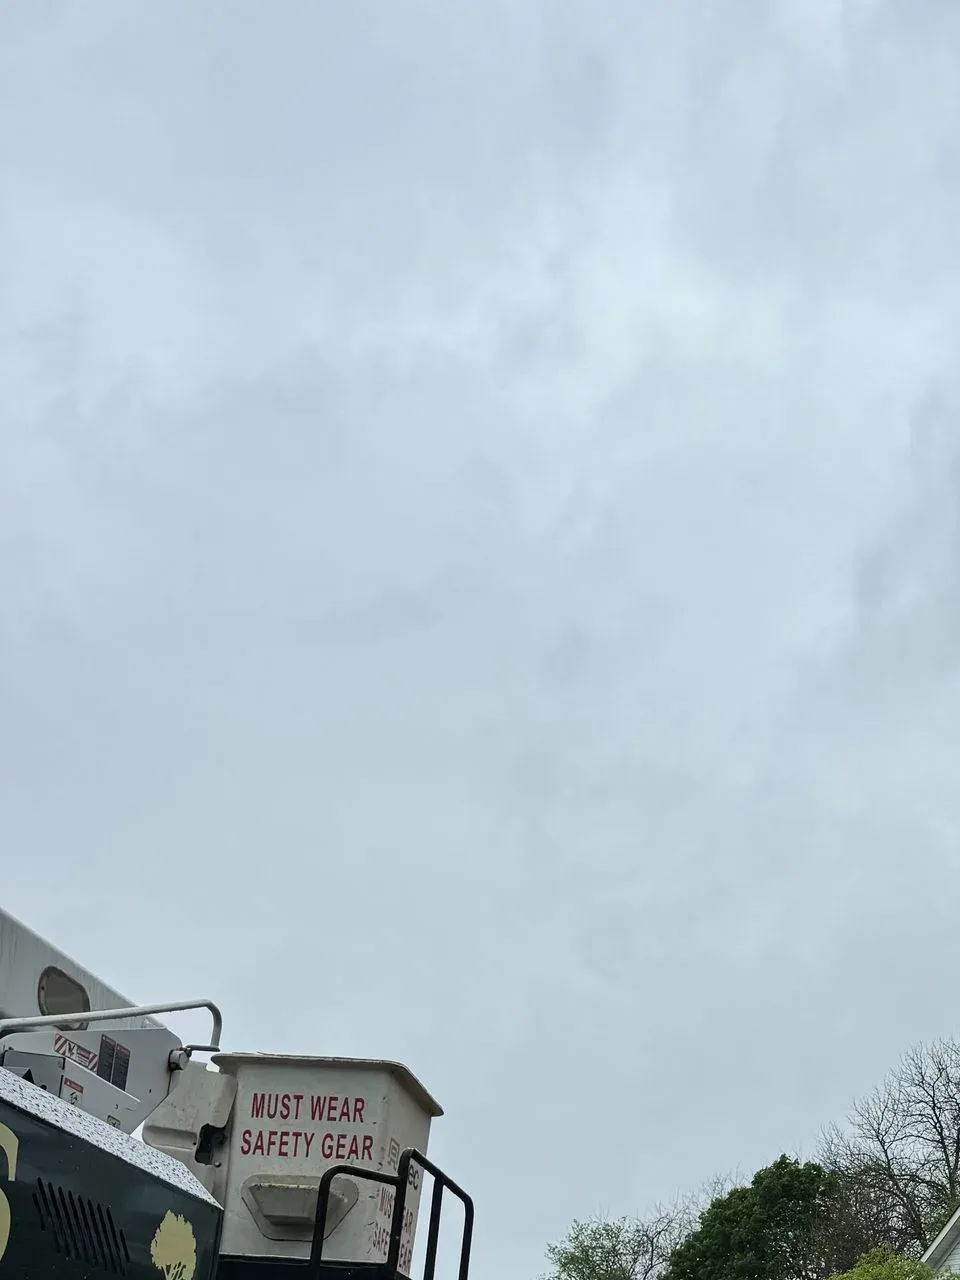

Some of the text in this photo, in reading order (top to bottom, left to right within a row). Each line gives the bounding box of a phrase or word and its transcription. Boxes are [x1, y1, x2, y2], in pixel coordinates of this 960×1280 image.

[251, 1093, 365, 1123] MUST WEAR
[240, 1129, 374, 1161] SAFETY GEAR
[379, 1187, 394, 1219] MUS
[372, 1221, 390, 1256] SAFE
